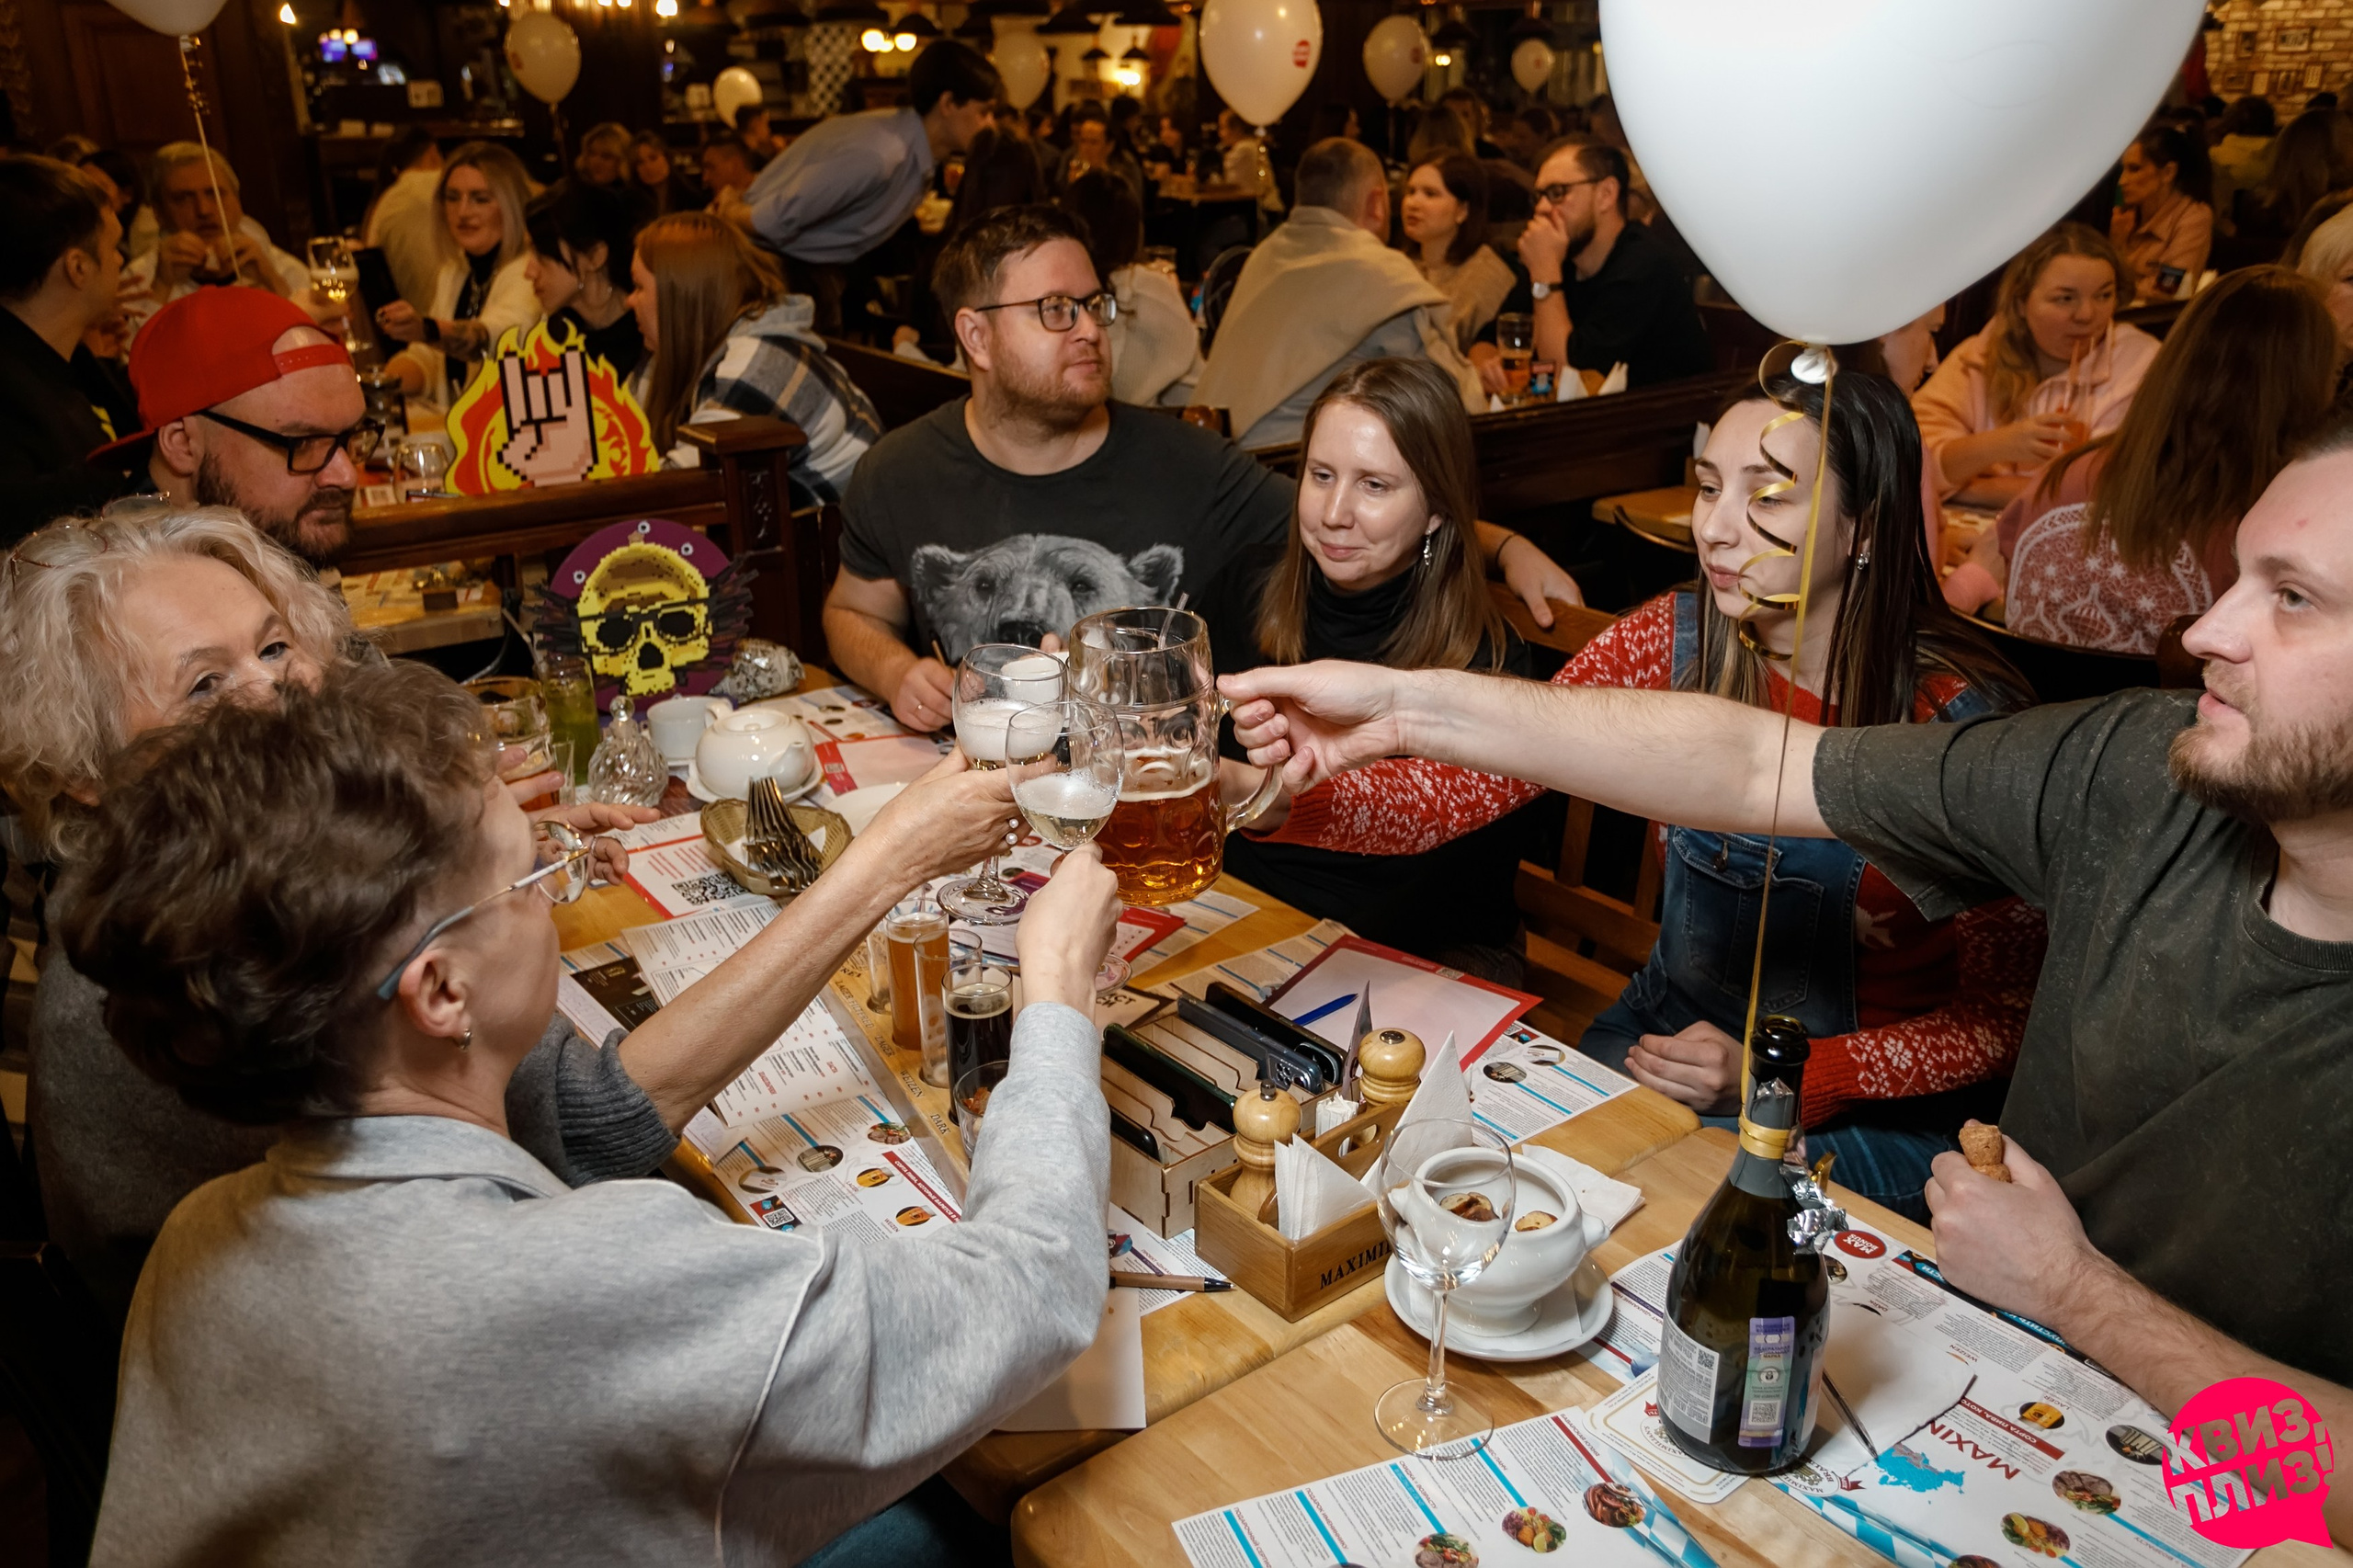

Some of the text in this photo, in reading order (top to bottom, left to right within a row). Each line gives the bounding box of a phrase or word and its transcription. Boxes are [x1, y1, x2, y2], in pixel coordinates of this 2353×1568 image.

[835, 981, 852, 1002] LAGER
[874, 1035, 894, 1058] LAGER
[900, 1069, 924, 1098] WEIZEN
[930, 1114, 951, 1135] DARK
[894, 1160, 907, 1173] СОРТА
[883, 1217, 899, 1233] WEIZEN
[1842, 1233, 1873, 1255] MAX
[1847, 1231, 1878, 1252] BONUS
[2018, 1313, 2065, 1347] ПУСТИТЬ
[1949, 1344, 1978, 1363] WEIZEN
[1985, 1413, 2014, 1433] ПИВА,
[1560, 1411, 1600, 1459] БАВАРСКАЯ КУХНЯ
[2014, 1428, 2037, 1444] СОРТА
[1398, 1460, 1415, 1482] СКИДКА
[1415, 1483, 1437, 1510] ВОЗРАСТУ
[1232, 1506, 1259, 1547] ПОДАРОЧНЫЙ
[1304, 1486, 1348, 1551] ПОДАРОК ИМЕНИННИКУ
